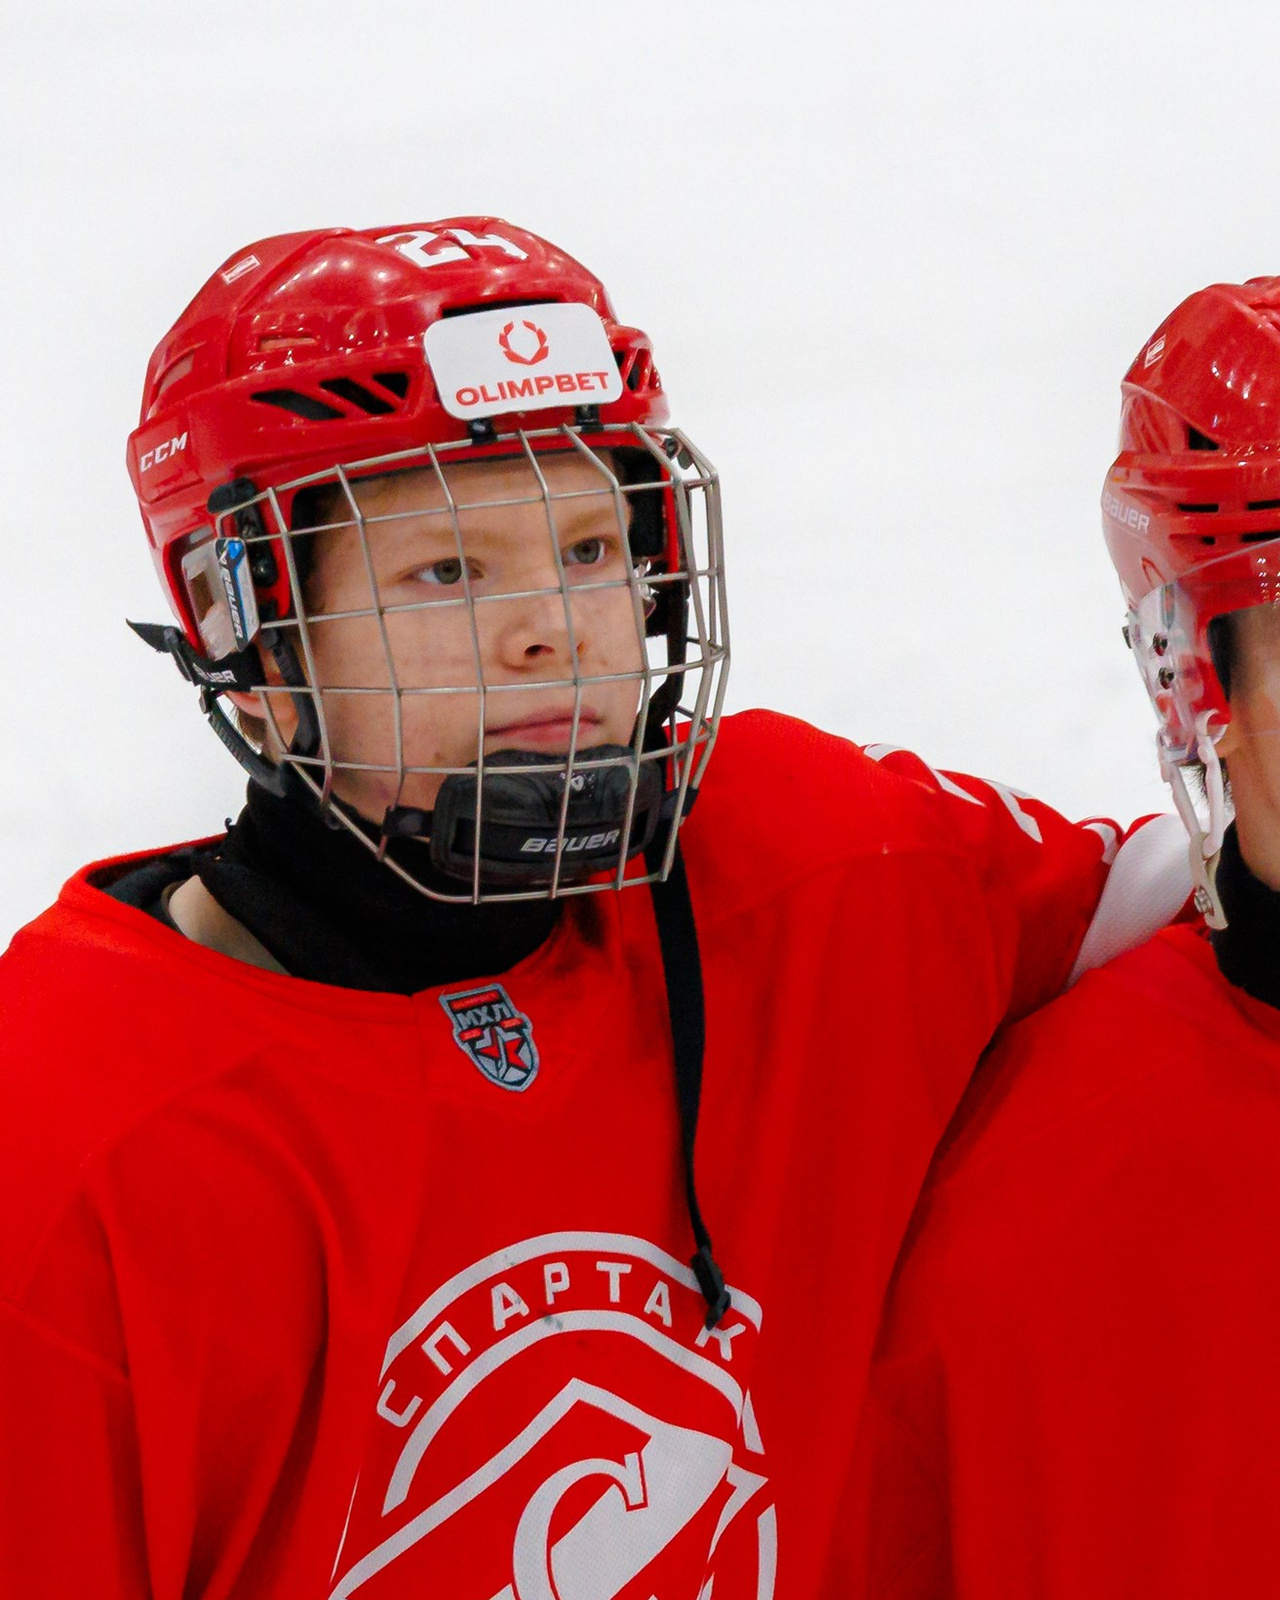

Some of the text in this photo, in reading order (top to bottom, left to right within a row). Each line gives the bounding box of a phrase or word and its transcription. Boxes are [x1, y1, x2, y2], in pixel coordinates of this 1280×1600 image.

[374, 228, 529, 269] 24
[455, 371, 610, 407] OLIMPBET
[139, 431, 189, 473] CCM
[520, 828, 620, 852] BAUER
[455, 1002, 512, 1030] МХЛ
[376, 1260, 747, 1428] СПАРТАК
